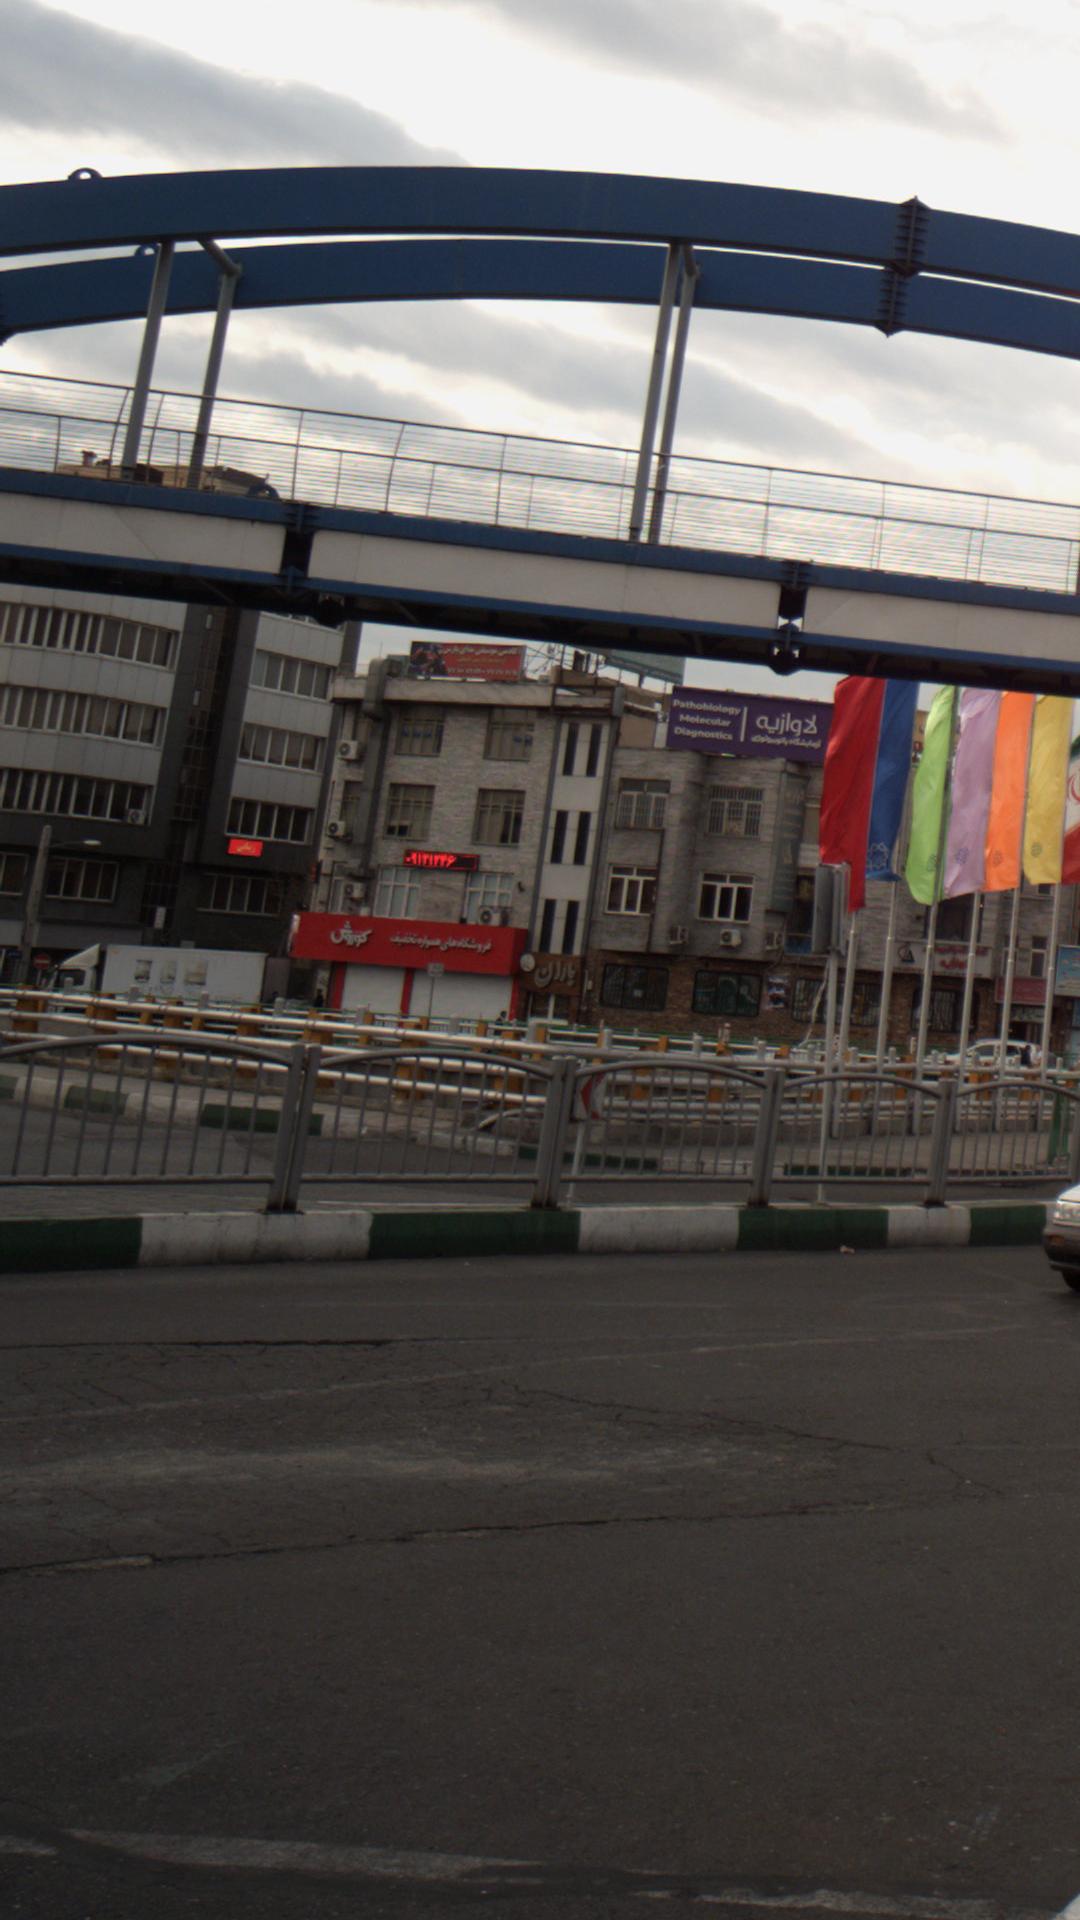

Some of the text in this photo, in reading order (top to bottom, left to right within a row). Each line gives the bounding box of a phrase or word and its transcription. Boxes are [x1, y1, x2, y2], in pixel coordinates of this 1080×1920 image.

[672, 699, 742, 716] Pathobiology
[679, 714, 731, 727] Molecular
[756, 712, 818, 737] لاوازیه
[674, 727, 734, 741] Diagnostics
[330, 920, 374, 947] کوروش
